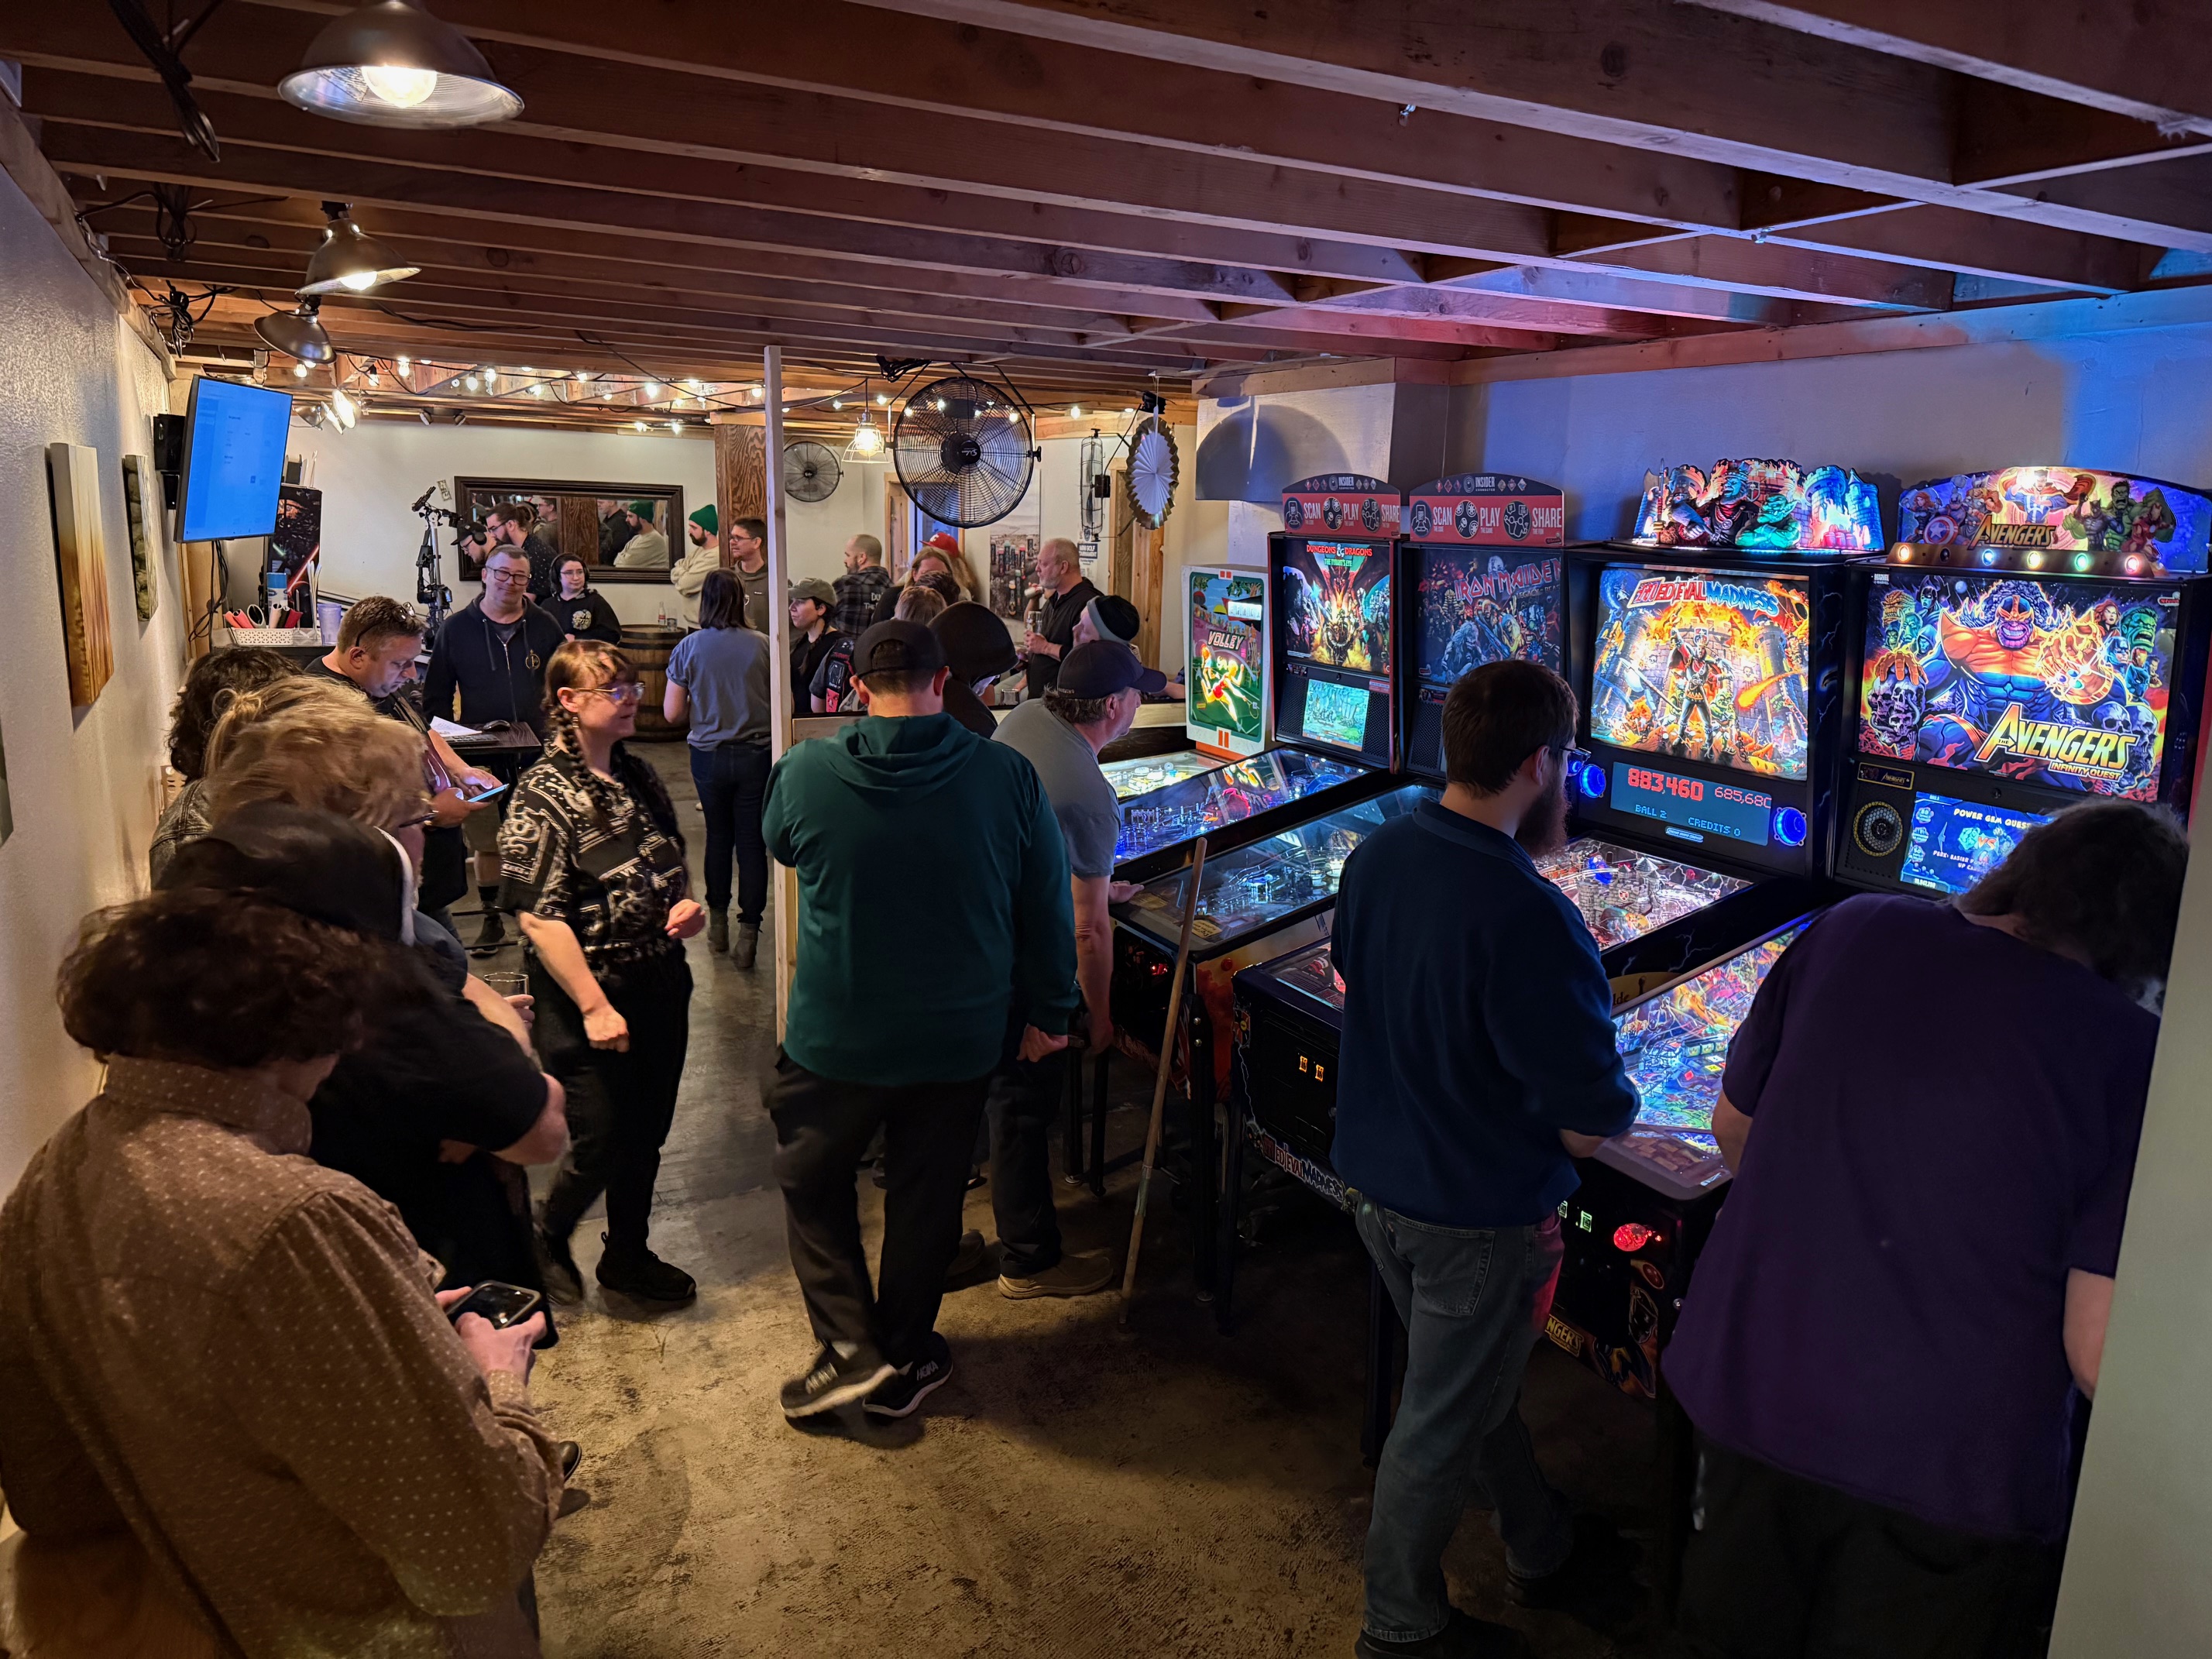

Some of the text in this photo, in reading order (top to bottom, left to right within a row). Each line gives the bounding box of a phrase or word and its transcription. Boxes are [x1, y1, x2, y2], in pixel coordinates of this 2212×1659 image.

[1338, 476, 1355, 486] INSIDER
[1475, 476, 1496, 488] INSIDER
[1304, 503, 1321, 519] SCAN
[1344, 503, 1359, 520] PLAY
[1381, 504, 1400, 523] SHARE
[1433, 507, 1452, 526] SCAN
[1480, 507, 1501, 527] PLAY
[1532, 507, 1562, 528] SHARE
[1967, 514, 2056, 550] AVENGERS
[1306, 544, 1337, 555] DUNGEONS
[1345, 548, 1372, 557] DRAGONS
[1454, 558, 1561, 605] IRON MAIDEN
[1630, 577, 1780, 617] MEDIEVAL MADNESS
[1208, 630, 1245, 650] VOLLEY
[1976, 703, 2138, 770] AVENGERS
[2051, 762, 2122, 780] INFINITY QUEST
[1628, 768, 1704, 802] 883,460
[1635, 804, 1668, 819] BALL 2
[1953, 808, 1983, 821] POWER
[1984, 815, 2002, 825] GEM
[1688, 816, 1731, 834] CREDITS
[1977, 836, 1997, 850] VS
[916, 1360, 939, 1381] HOKA
